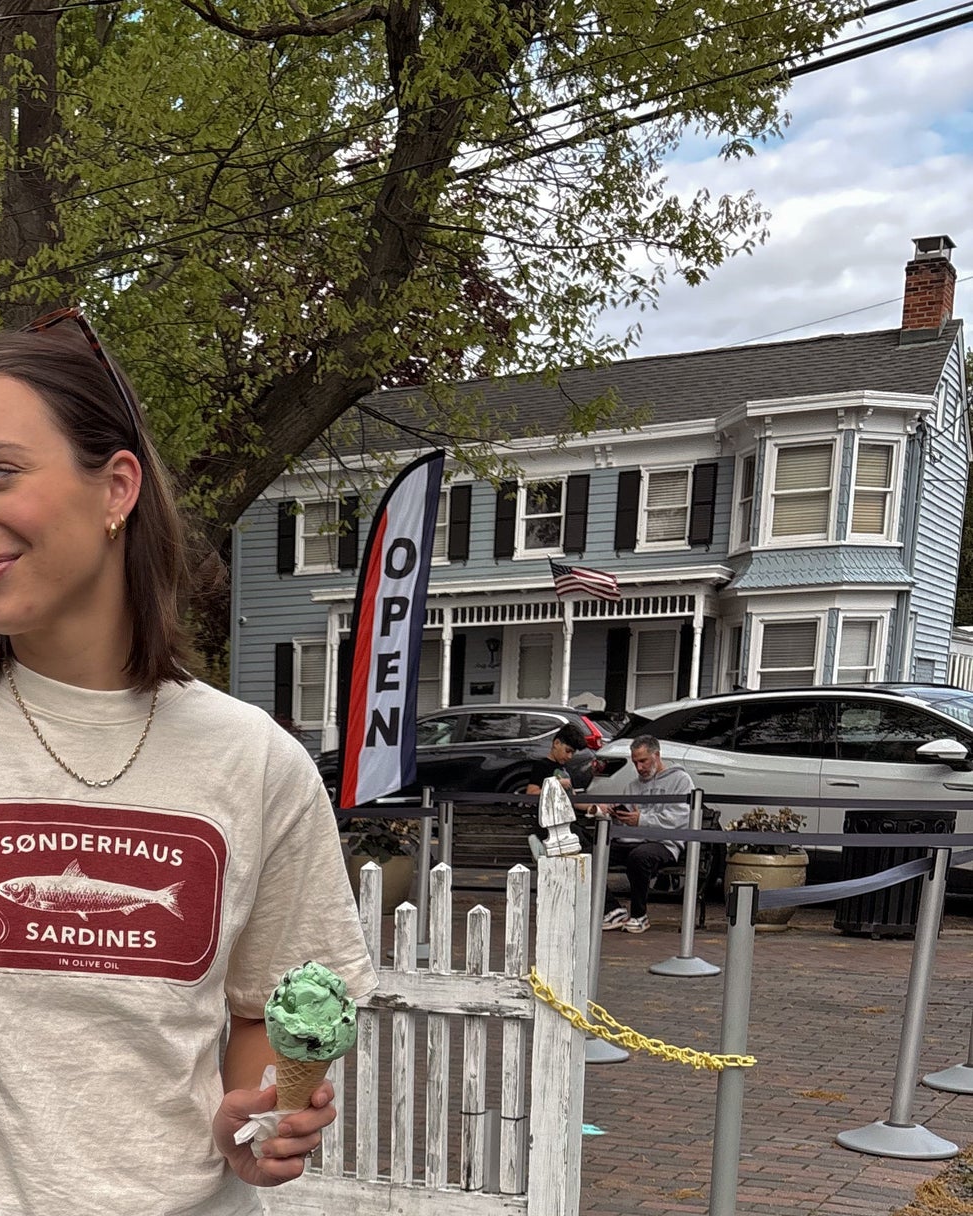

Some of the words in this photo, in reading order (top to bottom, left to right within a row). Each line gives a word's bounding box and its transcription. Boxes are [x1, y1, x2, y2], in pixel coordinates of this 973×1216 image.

[365, 537, 417, 747] OPEN
[0, 832, 184, 867] SØNDERHAUS
[25, 922, 157, 948] SARDINES
[58, 957, 69, 966] IN
[72, 959, 101, 968] OLIVE
[103, 961, 120, 970] OIL
